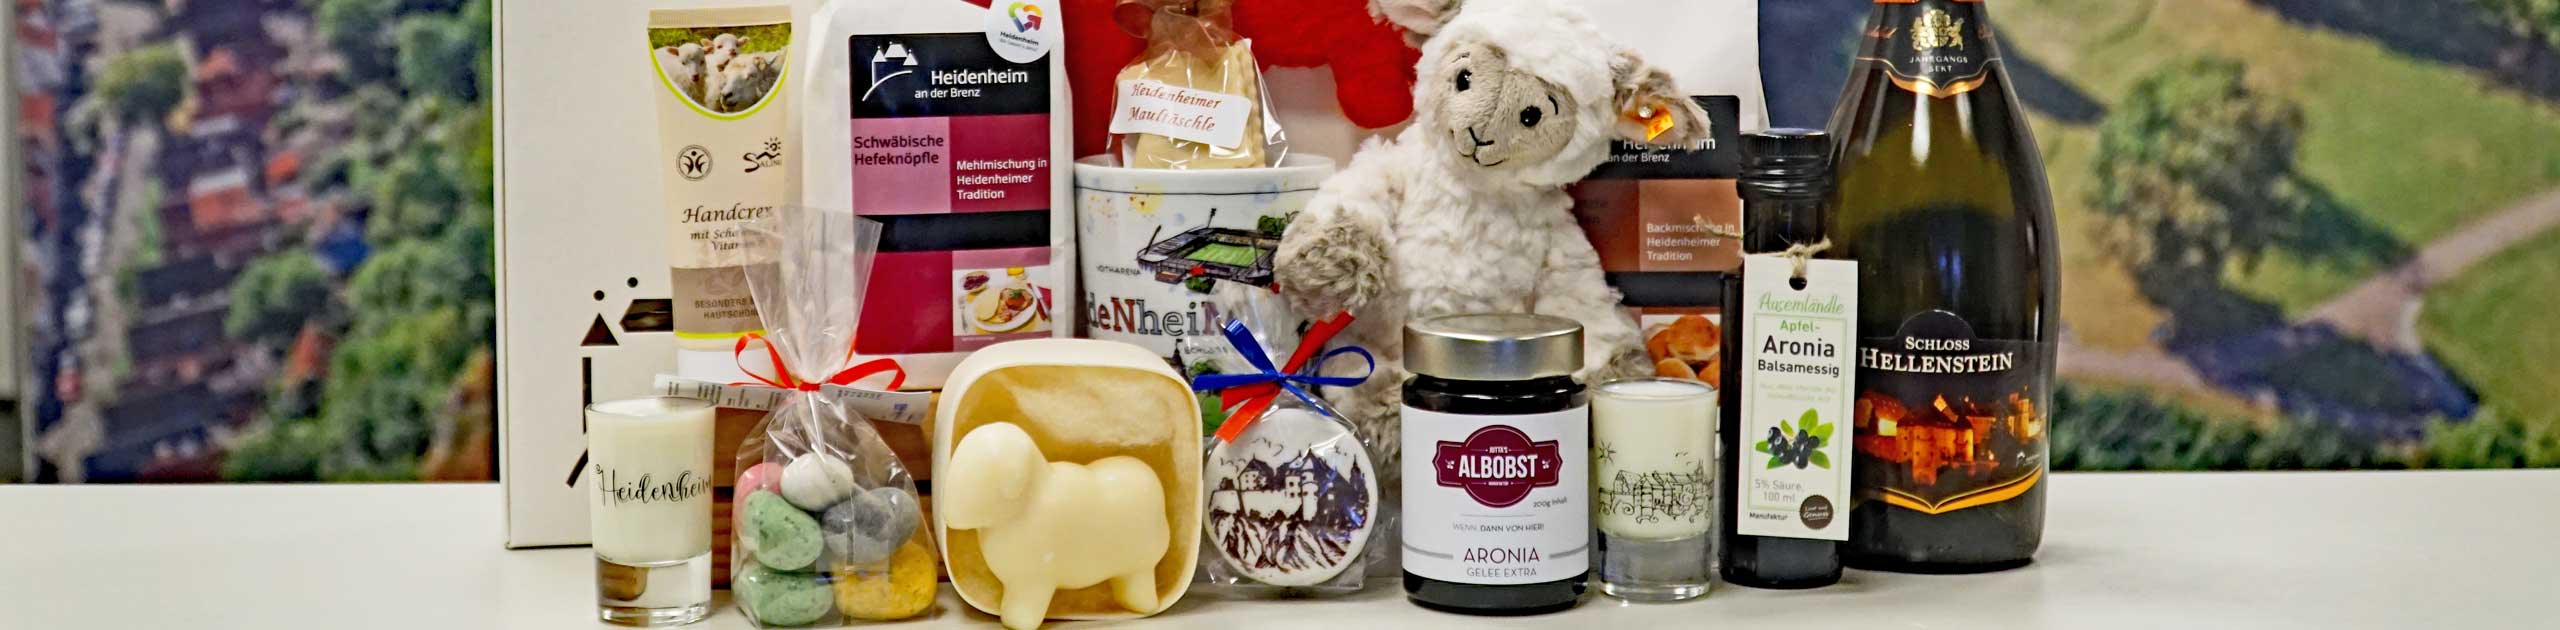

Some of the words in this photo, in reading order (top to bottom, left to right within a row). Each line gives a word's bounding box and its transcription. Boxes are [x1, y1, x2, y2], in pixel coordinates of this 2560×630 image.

[1000, 31, 1039, 46] Heidenheim
[931, 68, 1028, 86] Heidenheim
[914, 89, 928, 99] an
[930, 87, 948, 99] der
[950, 87, 981, 98] Brenz
[1130, 83, 1222, 109] Heidenheimer
[853, 135, 944, 149] Schwäbische
[853, 152, 940, 167] Hefeknöpfle
[1621, 152, 1639, 162] der
[1641, 152, 1670, 162] Brenz
[956, 159, 1036, 172] Mehlmischung
[1037, 158, 1048, 168] in
[956, 173, 1033, 185] Heidenheimer
[956, 188, 1005, 200] Tradition
[690, 229, 709, 240] mit
[1725, 222, 1735, 233] in
[1646, 237, 1721, 247] Heidenheimer
[1646, 250, 1693, 261] Tradition
[1780, 319, 1821, 333] Apfel-
[1762, 334, 1835, 358] Aronia
[1905, 336, 1970, 351] SCHLOSS
[1860, 347, 2013, 373] HELLENSTEIN
[1757, 359, 1840, 378] Balsamessig
[1458, 454, 1538, 479] ALBOBST
[1754, 478, 1770, 490] 5%
[1772, 479, 1805, 492] Säure,
[1763, 491, 1780, 502] 100
[1782, 492, 1796, 503] ml
[1749, 511, 1788, 521] Manufaktur
[1480, 524, 1504, 532] DANN
[1506, 524, 1523, 532] VON
[1463, 547, 1541, 564] ARONIA
[1467, 568, 1500, 578] GELEE
[1504, 568, 1537, 578] EXTRA
